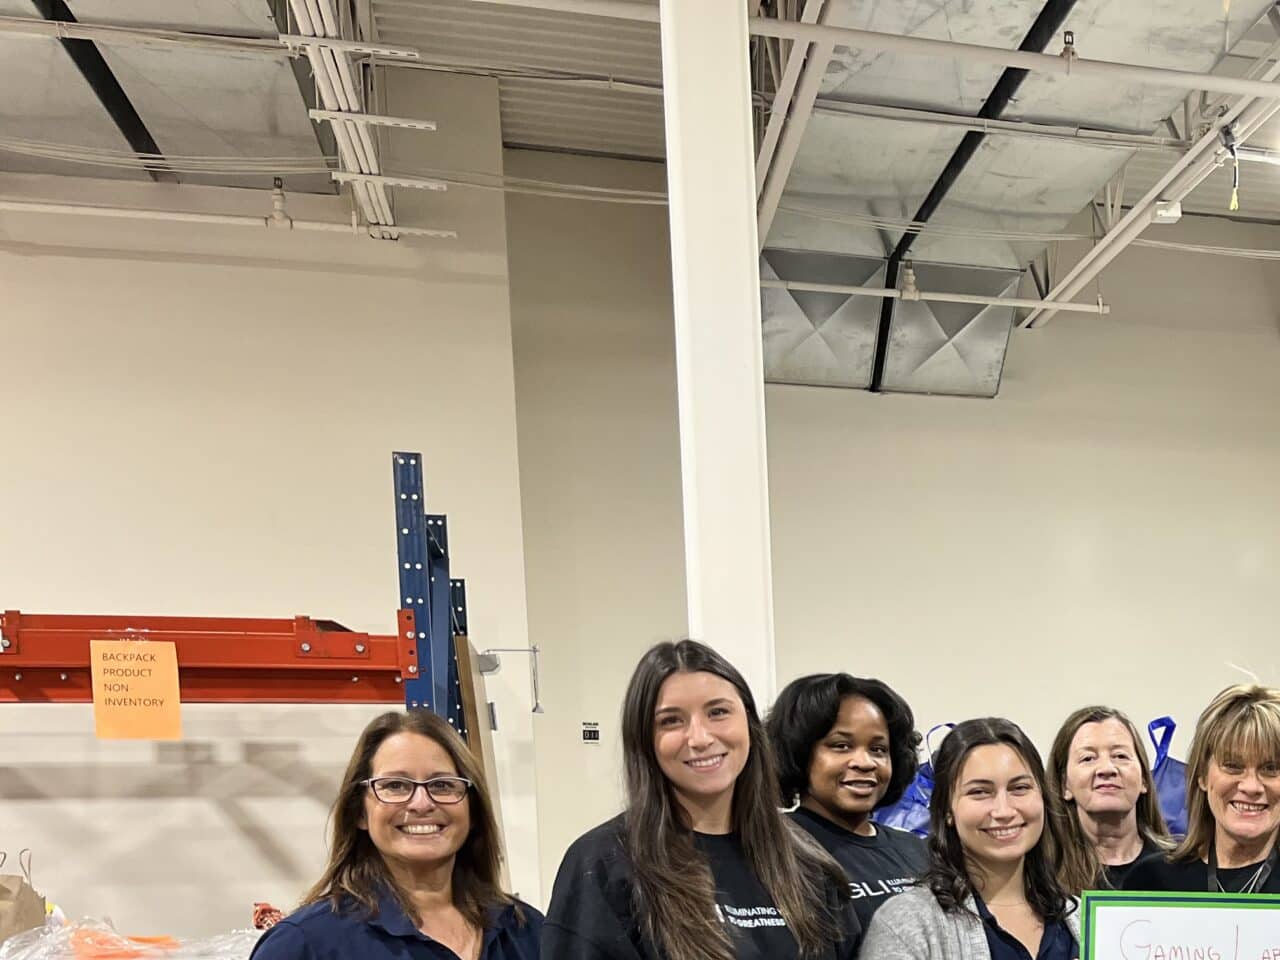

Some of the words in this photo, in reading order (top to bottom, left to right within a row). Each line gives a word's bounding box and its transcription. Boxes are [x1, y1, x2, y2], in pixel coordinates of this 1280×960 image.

[102, 653, 156, 662] BACKPACK
[103, 668, 152, 677] PRODUCT
[104, 697, 164, 707] INVENTORY
